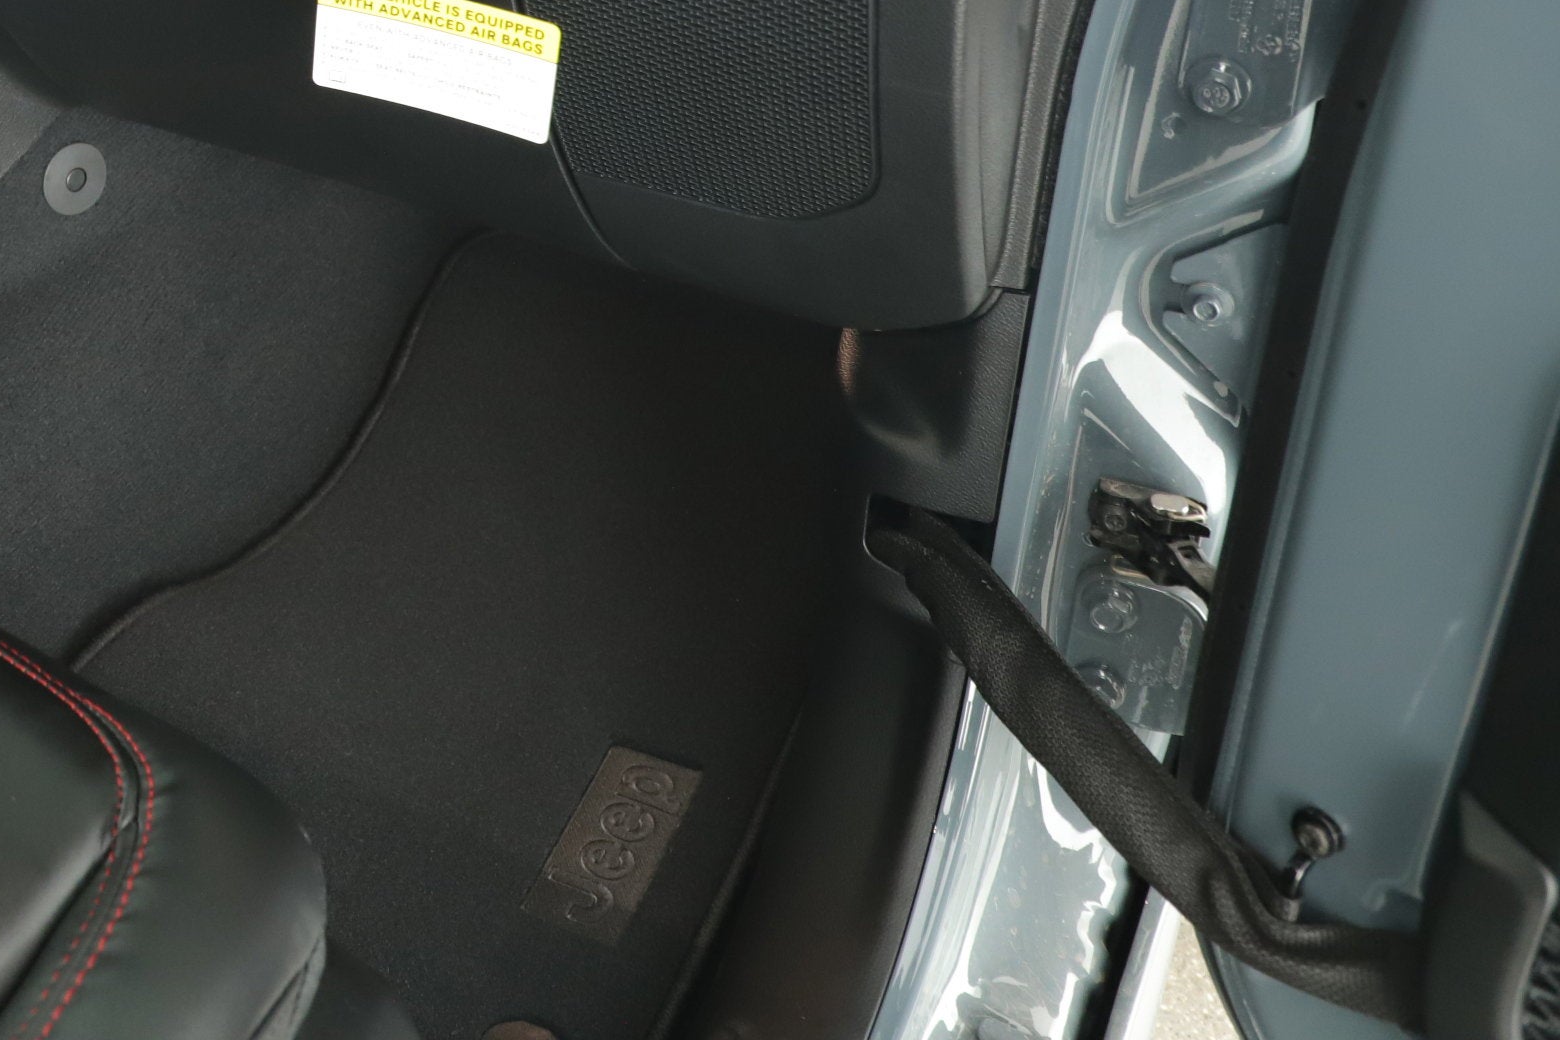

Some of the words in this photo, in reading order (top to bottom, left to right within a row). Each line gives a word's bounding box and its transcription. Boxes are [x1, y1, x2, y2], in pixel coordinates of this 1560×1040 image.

[378, 3, 466, 33] ADVANCED
[470, 25, 497, 41] AIR
[501, 34, 544, 56] BAGS
[446, 4, 461, 18] IS
[465, 9, 546, 41] EQUIPPED
[548, 764, 682, 924] Jeep
